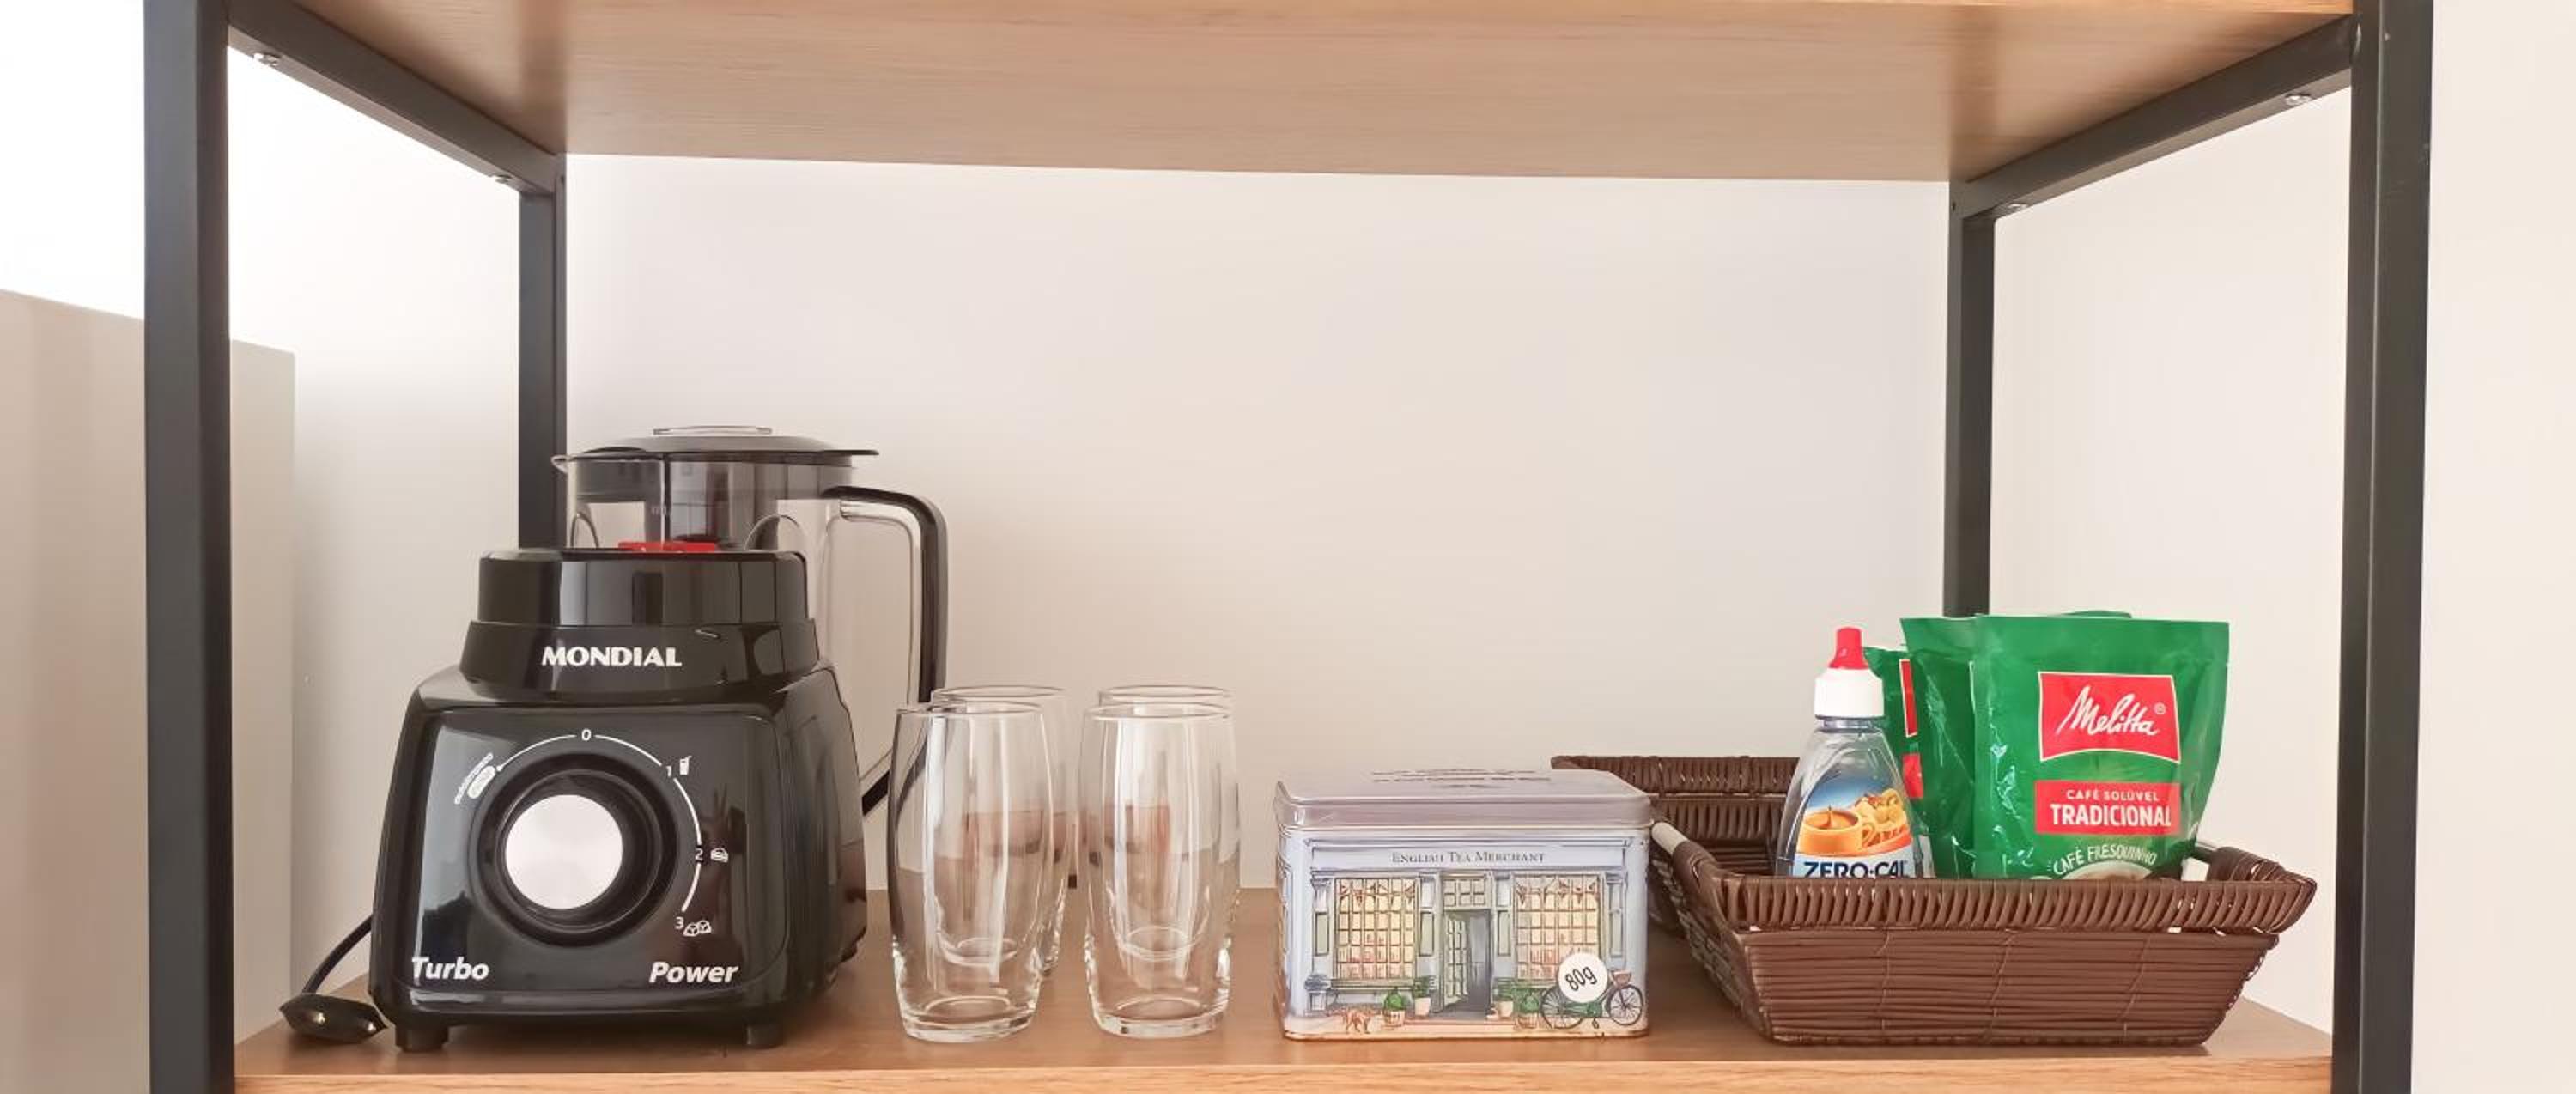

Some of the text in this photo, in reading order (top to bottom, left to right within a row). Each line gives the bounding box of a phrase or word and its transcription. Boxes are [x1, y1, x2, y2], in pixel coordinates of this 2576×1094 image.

[542, 647, 682, 666] MONDIAL
[2056, 685, 2159, 735] Melitta
[2066, 788, 2100, 800] CAFÉ
[2050, 803, 2172, 826] TRADICIONAL
[1392, 851, 1545, 863] ENGLISH TEA MERCHANT
[411, 957, 489, 981] Turbo
[649, 961, 739, 983] Power
[1565, 967, 1598, 991] 80g
